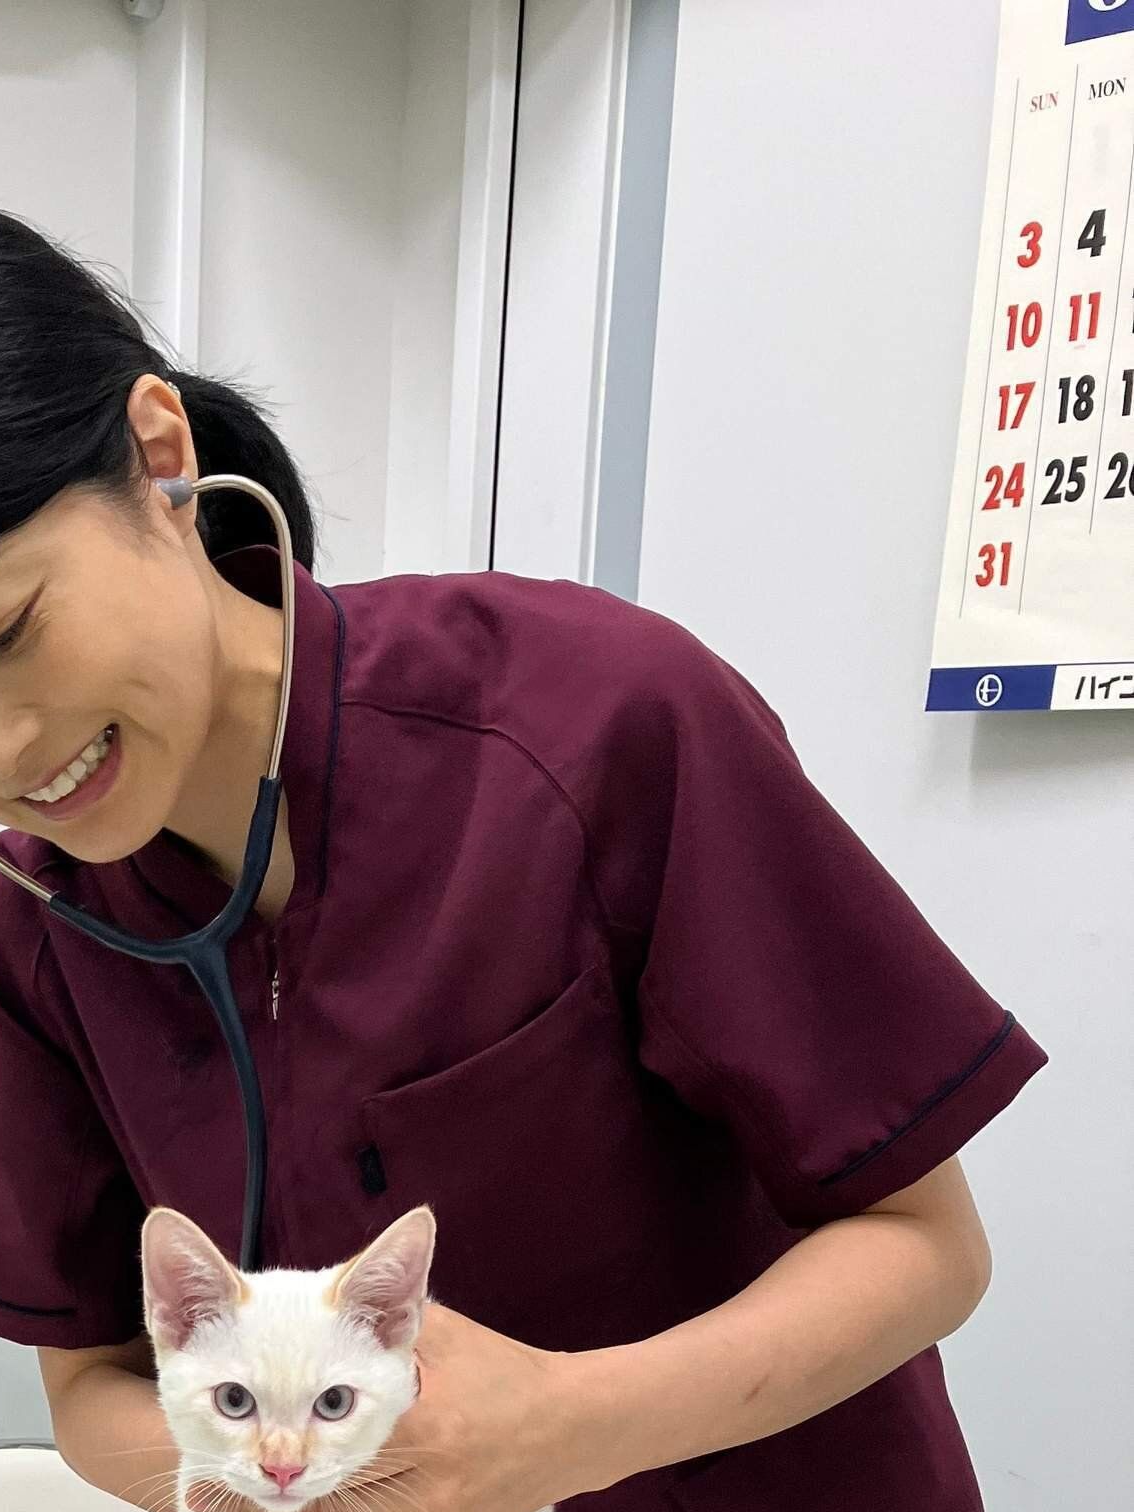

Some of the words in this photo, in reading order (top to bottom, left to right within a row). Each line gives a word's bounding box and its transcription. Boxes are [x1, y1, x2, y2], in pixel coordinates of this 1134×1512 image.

[1029, 91, 1059, 113] SUN
[1088, 78, 1126, 101] MON
[1017, 221, 1043, 268] 3
[1077, 209, 1106, 258] 4
[1006, 302, 1043, 352] 10
[1068, 292, 1102, 342] 11
[997, 381, 1036, 431] 17
[1058, 374, 1096, 424] 18
[1122, 368, 1134, 417] 1
[981, 462, 1026, 511] 24
[1041, 455, 1088, 506] 25
[1103, 451, 1134, 500] 2
[975, 542, 1013, 588] 31
